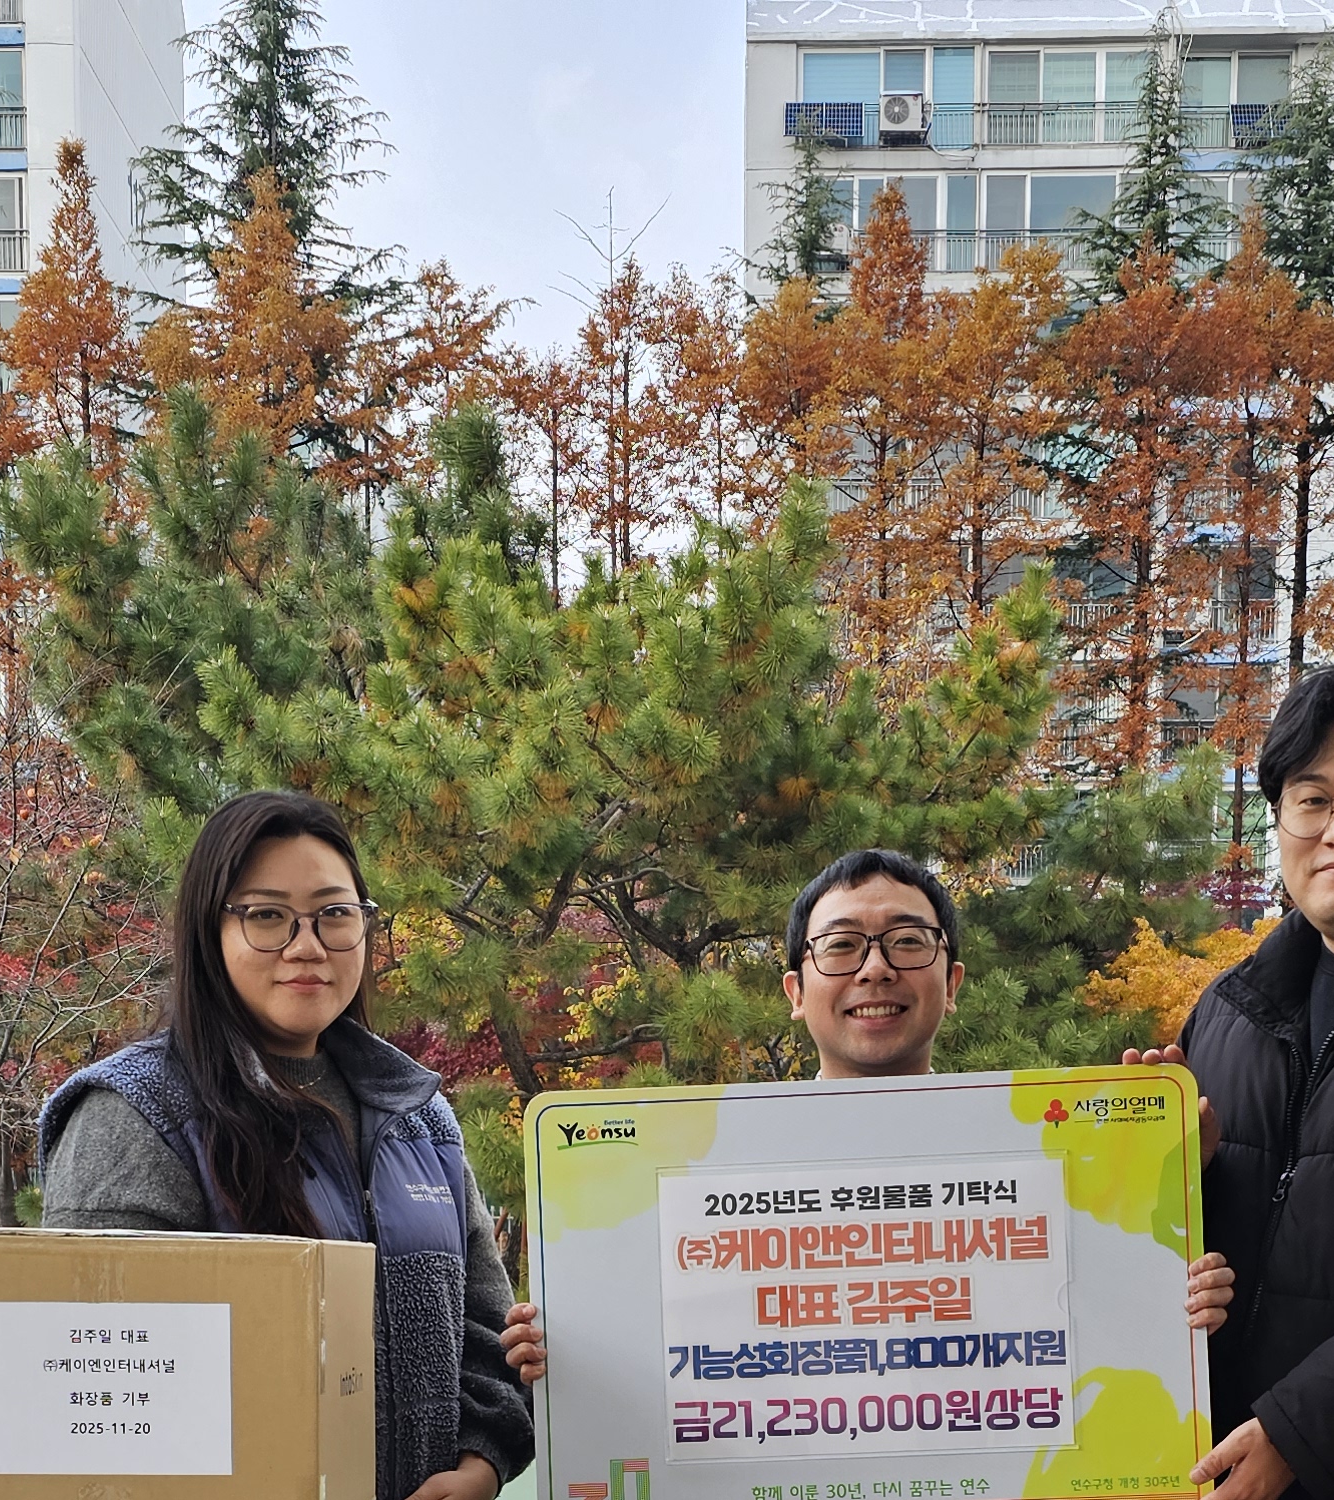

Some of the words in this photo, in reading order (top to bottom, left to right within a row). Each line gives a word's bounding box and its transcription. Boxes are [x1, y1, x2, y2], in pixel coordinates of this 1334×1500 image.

[1074, 1096, 1165, 1117] 사랑의열매
[557, 1122, 636, 1147] Yeonsu
[704, 1188, 822, 1217] 2025년도
[830, 1183, 933, 1213] 후원물품
[941, 1179, 1018, 1206] 기탁식
[755, 1284, 841, 1328] 대표
[847, 1277, 973, 1325] 김주일
[70, 1329, 111, 1344] 김주일
[121, 1330, 149, 1344] 대표
[70, 1392, 113, 1406] 화장품
[123, 1392, 150, 1406] 기부
[673, 1387, 1064, 1445] 금21,230,000원상당
[71, 1423, 150, 1434] 2025-11-20
[825, 1483, 866, 1500] 30년,
[873, 1481, 903, 1498] 다시
[909, 1479, 953, 1497] 꿈꾸는
[959, 1478, 991, 1496] 연수
[1071, 1478, 1113, 1491] 연수구청
[1118, 1476, 1139, 1489] 개청
[1144, 1475, 1180, 1488] 30주년
